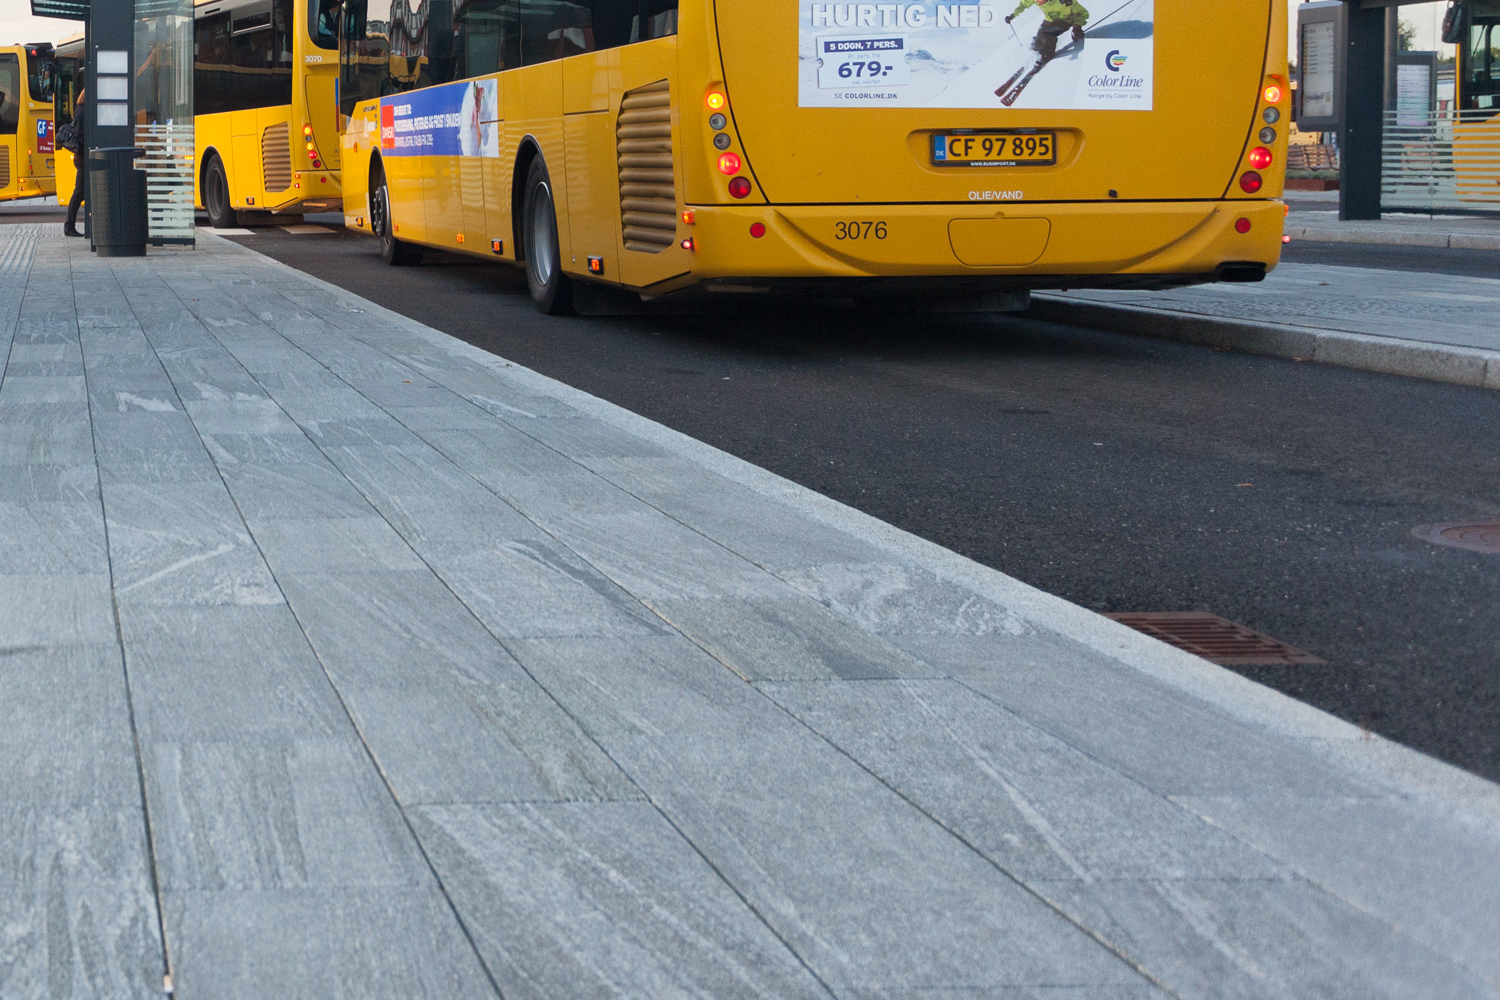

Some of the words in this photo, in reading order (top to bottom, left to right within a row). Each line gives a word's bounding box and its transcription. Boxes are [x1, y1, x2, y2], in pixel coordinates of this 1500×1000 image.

[811, 4, 927, 27] HURTIG
[935, 4, 998, 28] NED
[837, 42, 864, 51] DØGN,
[873, 40, 898, 49] PERS.
[304, 55, 323, 63] 3070
[838, 61, 893, 78] 679.-
[37, 121, 46, 134] GF
[948, 138, 975, 157] CF
[982, 137, 1006, 157] 97
[1012, 137, 1049, 156] 895
[968, 190, 1023, 200] OLIE/VAND
[835, 221, 887, 240] 3076
